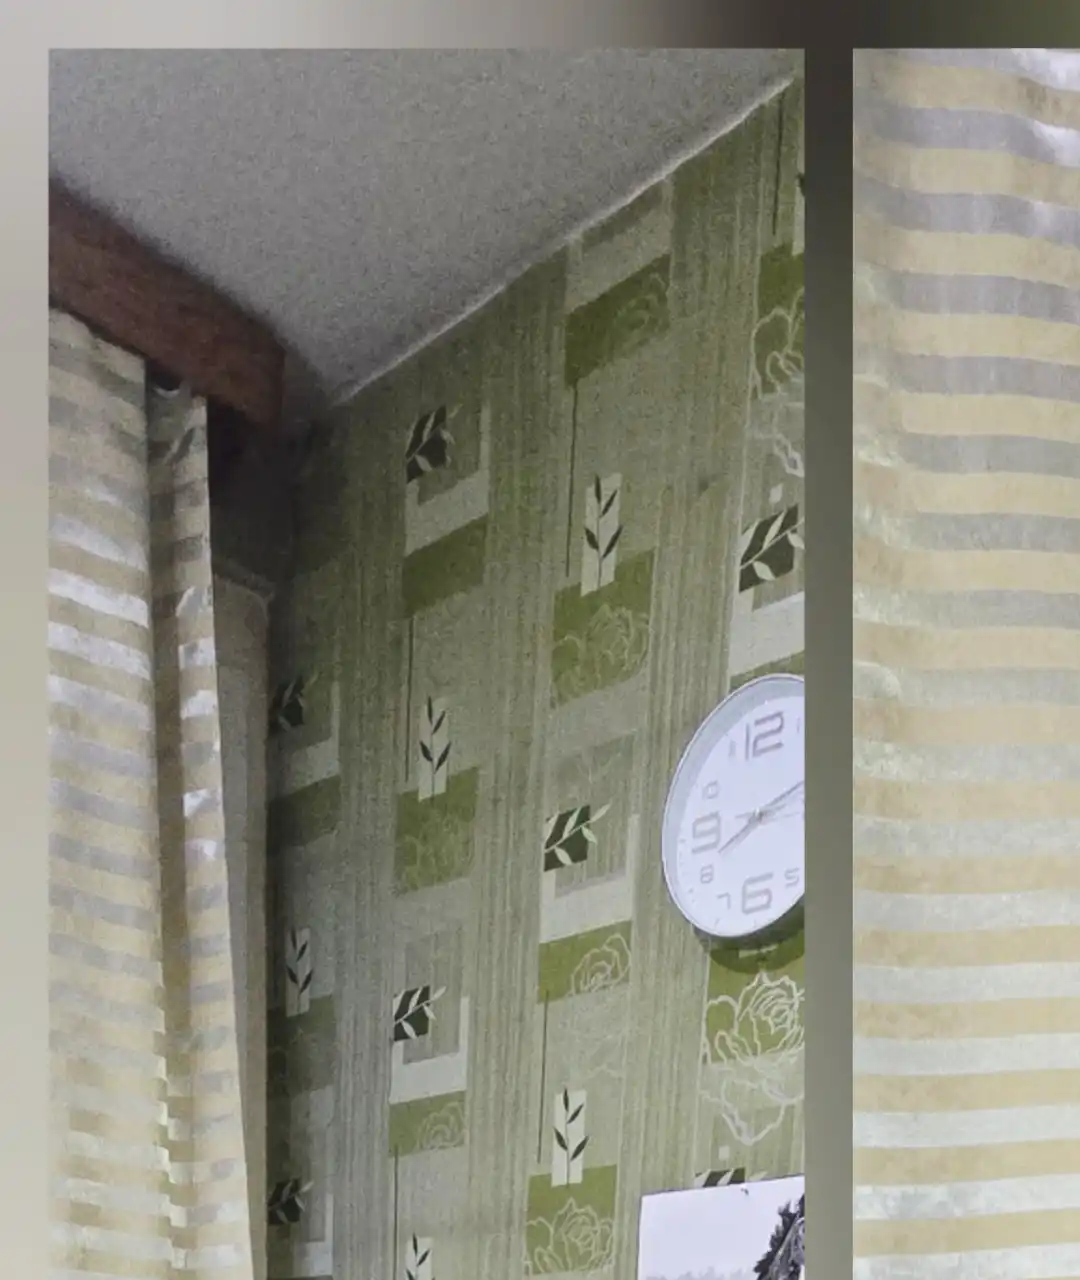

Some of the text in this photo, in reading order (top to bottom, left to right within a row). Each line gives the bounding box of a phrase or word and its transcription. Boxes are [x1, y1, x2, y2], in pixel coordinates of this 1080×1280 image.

[744, 710, 785, 762] 12
[691, 810, 721, 854] 9
[699, 863, 714, 884] 8
[784, 867, 800, 889] 5
[716, 891, 732, 910] 7
[741, 872, 773, 915] 6
